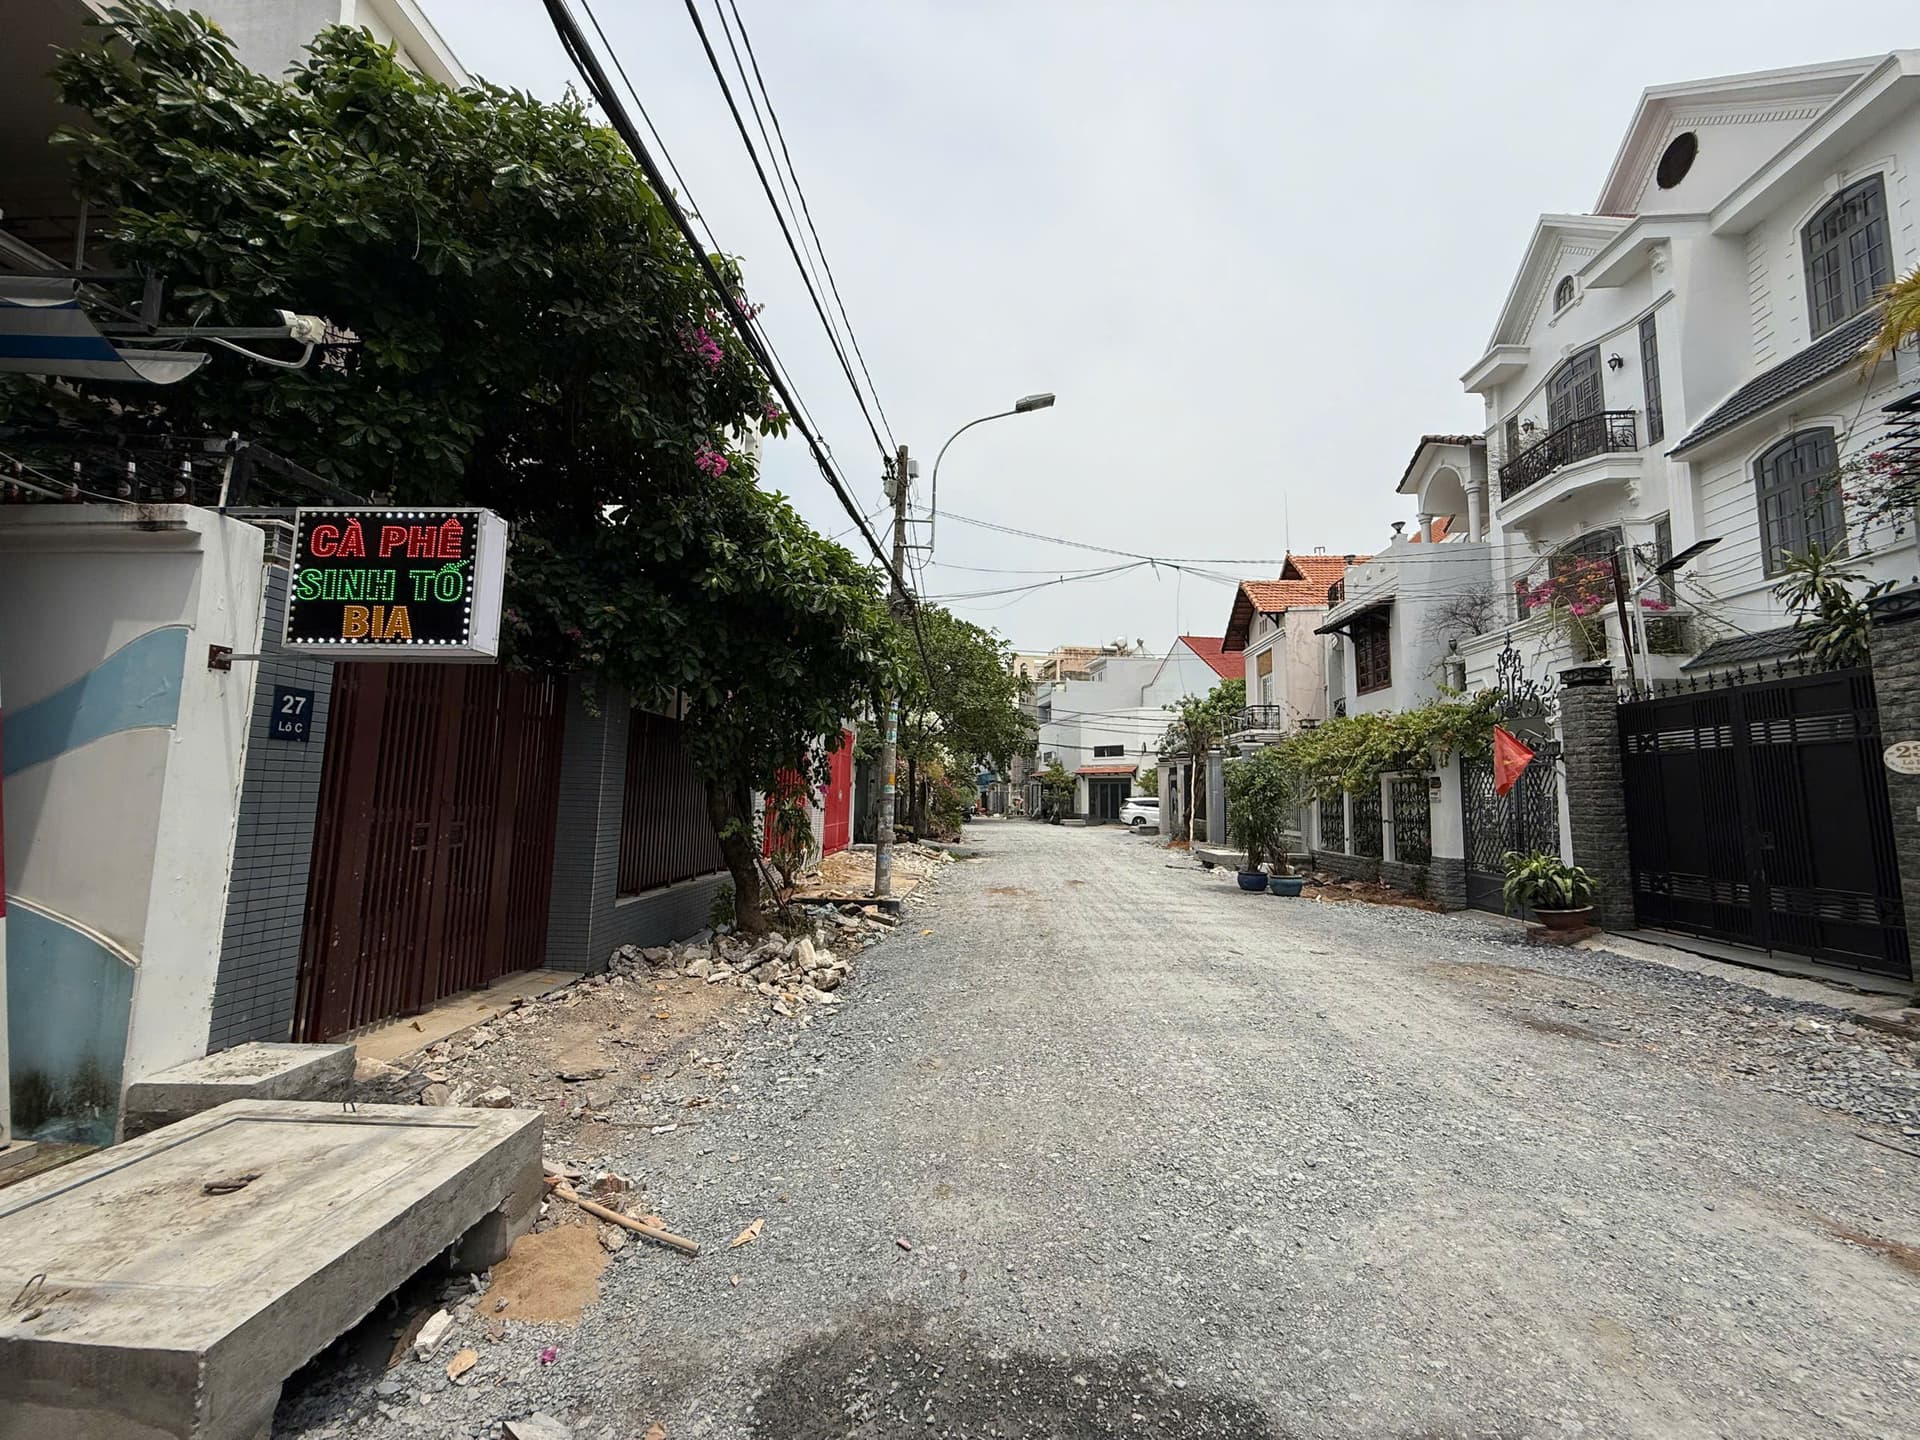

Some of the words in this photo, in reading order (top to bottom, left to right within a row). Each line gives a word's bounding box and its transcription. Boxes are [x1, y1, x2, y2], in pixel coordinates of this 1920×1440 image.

[310, 518, 366, 558] CÀ
[378, 518, 464, 558] PHÊ
[296, 568, 396, 601] SINH
[409, 559, 470, 602] TỐ
[342, 605, 412, 639] BIA
[281, 695, 306, 715] 27
[294, 722, 303, 733] C
